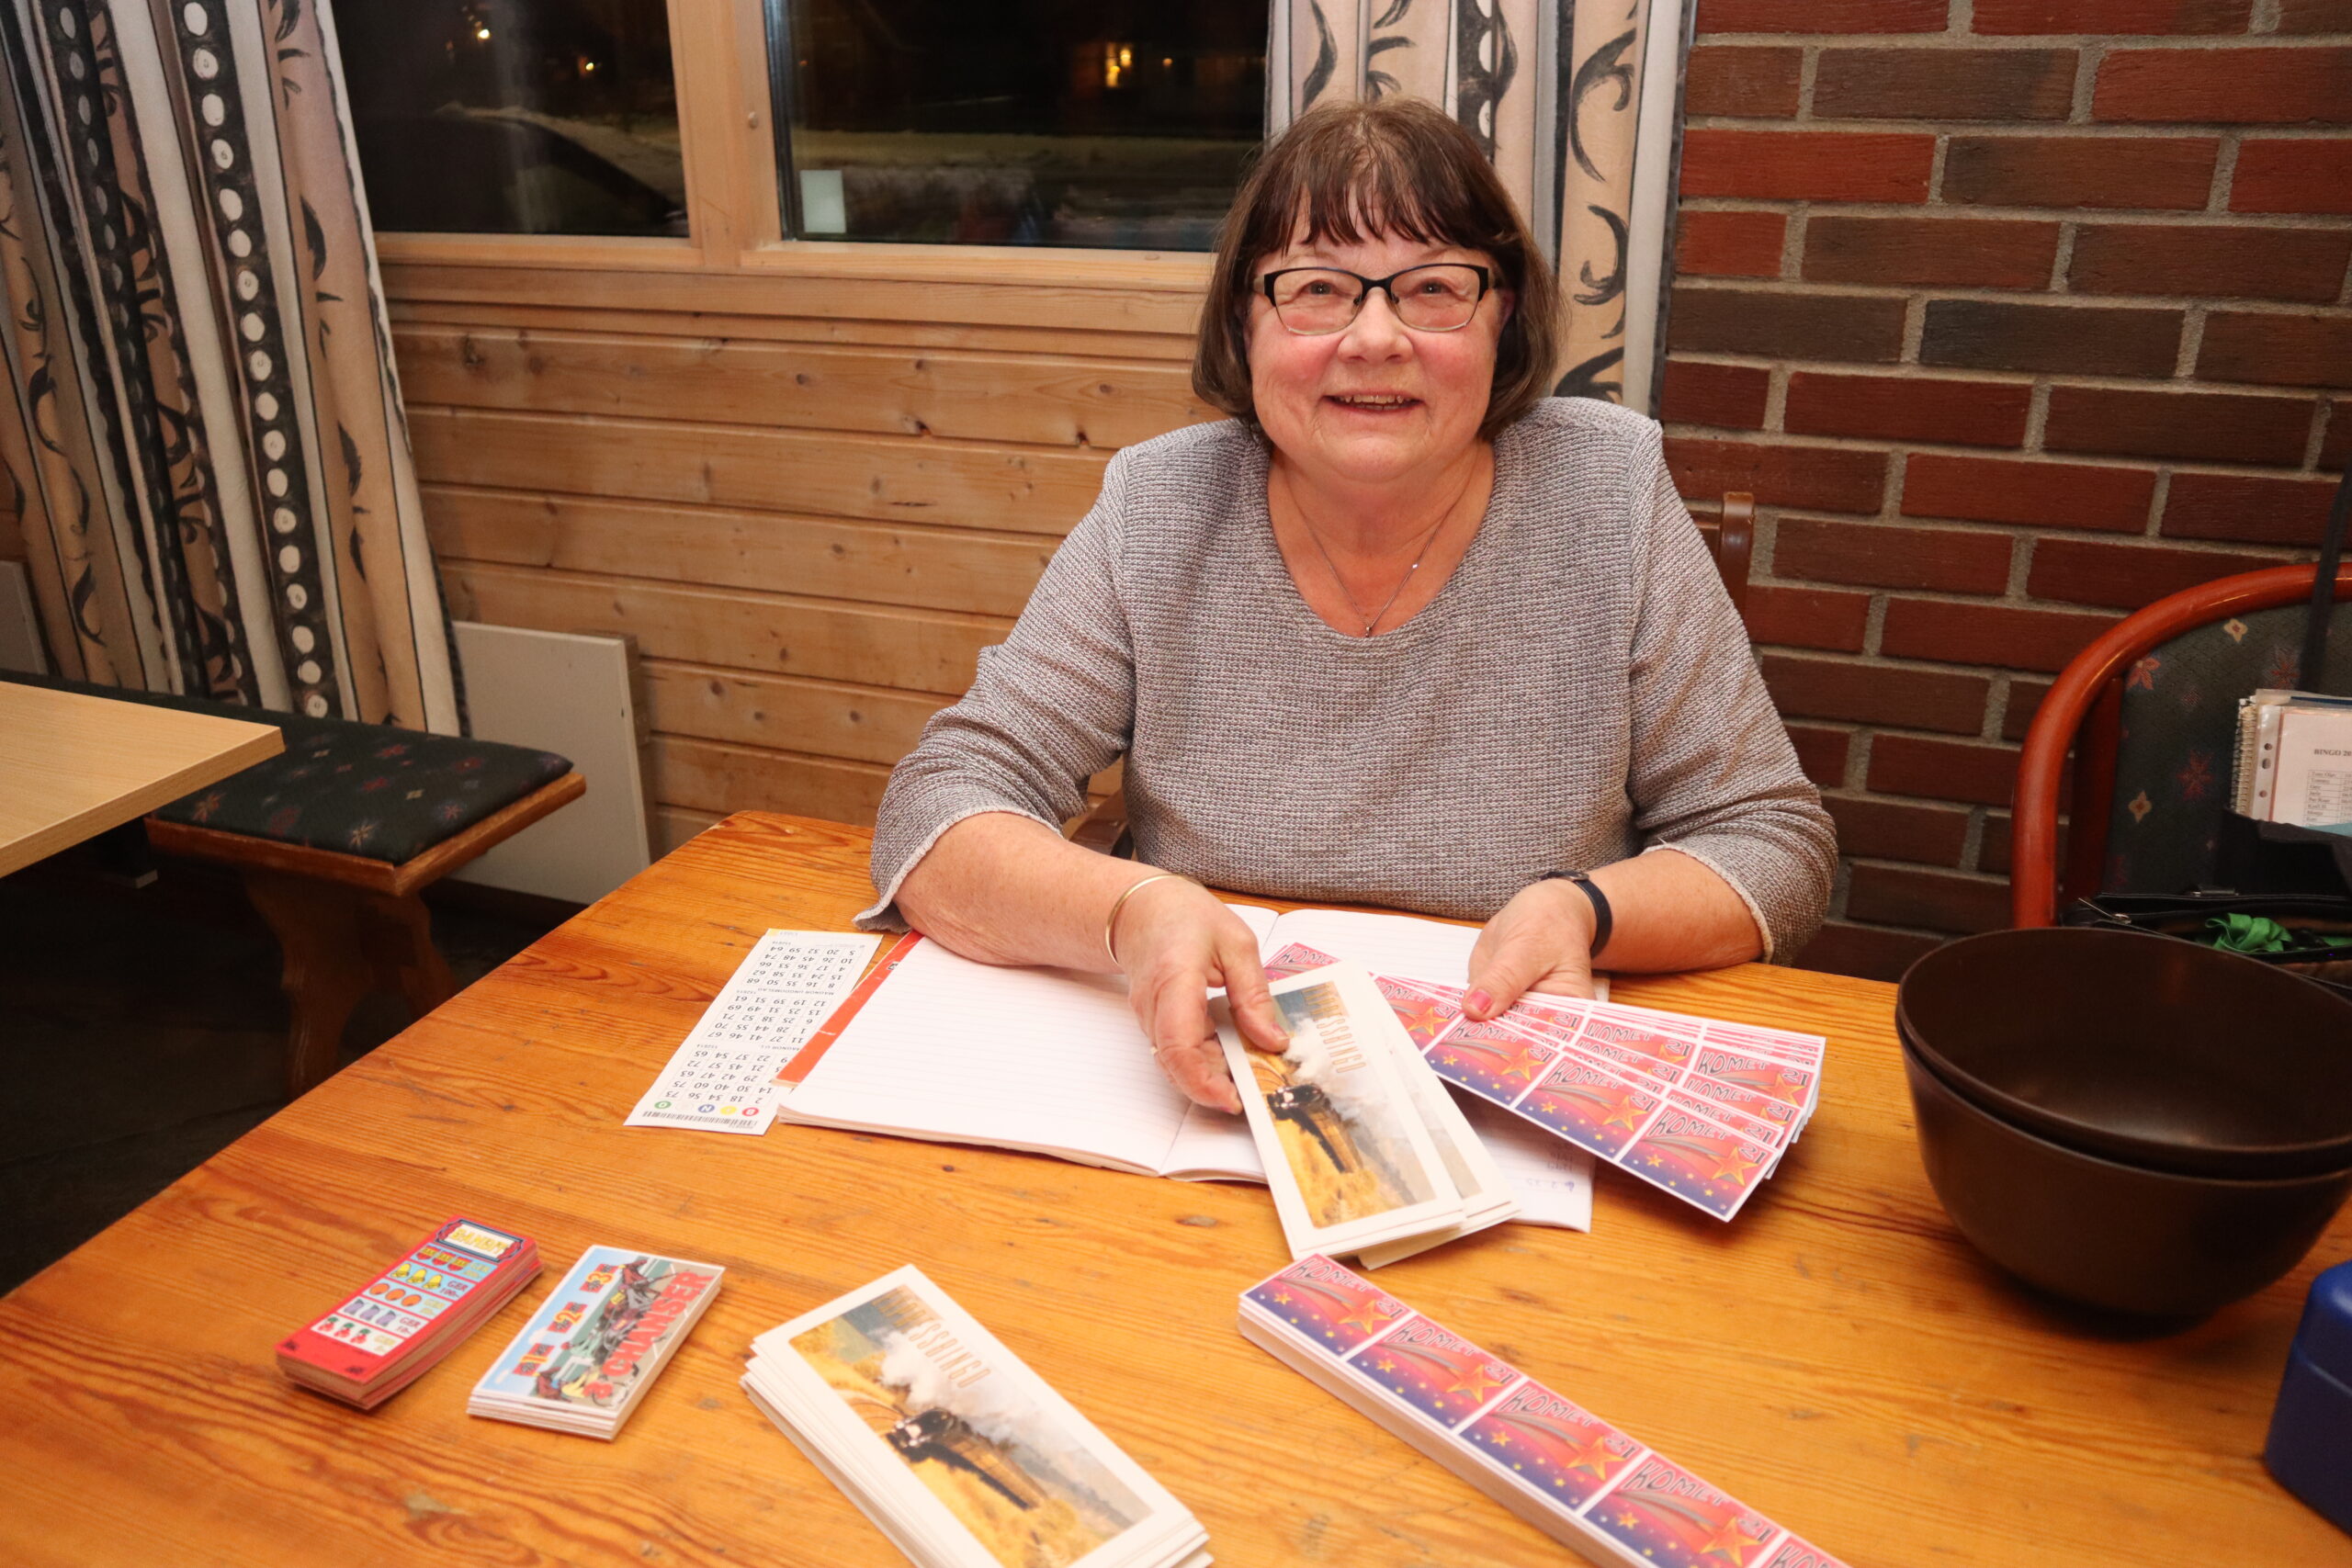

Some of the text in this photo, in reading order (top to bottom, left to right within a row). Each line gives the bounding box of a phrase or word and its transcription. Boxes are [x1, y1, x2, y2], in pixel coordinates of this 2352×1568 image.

[1273, 946, 1340, 965] KOME
[1375, 980, 1430, 1003] OMET
[1434, 1002, 1459, 1020] 21
[1555, 1012, 1579, 1030] 21
[1446, 1019, 1523, 1043] KOMET
[1528, 1043, 1555, 1064] 21
[1586, 1022, 1692, 1057] KOMET 21
[1543, 1058, 1657, 1112] KOMET 21
[1653, 1062, 1681, 1082] 21
[1698, 1051, 1770, 1076] KOMET
[1782, 1067, 1810, 1088] 21
[1766, 1102, 1794, 1122] 21
[1647, 1109, 1769, 1164] KOMET 21
[1746, 1122, 1774, 1145] 21
[449, 1228, 507, 1255] BANDIT
[447, 1280, 469, 1292] GER
[586, 1270, 615, 1286] 3
[1285, 1258, 1406, 1319] KOMET 21
[399, 1316, 421, 1328] GER
[554, 1310, 584, 1325] 2
[582, 1270, 714, 1400] 3 CHANSER
[1386, 1319, 1516, 1384] KOMET 21
[1499, 1386, 1638, 1459] KOMET 21
[1622, 1461, 1775, 1544] KOMET 21
